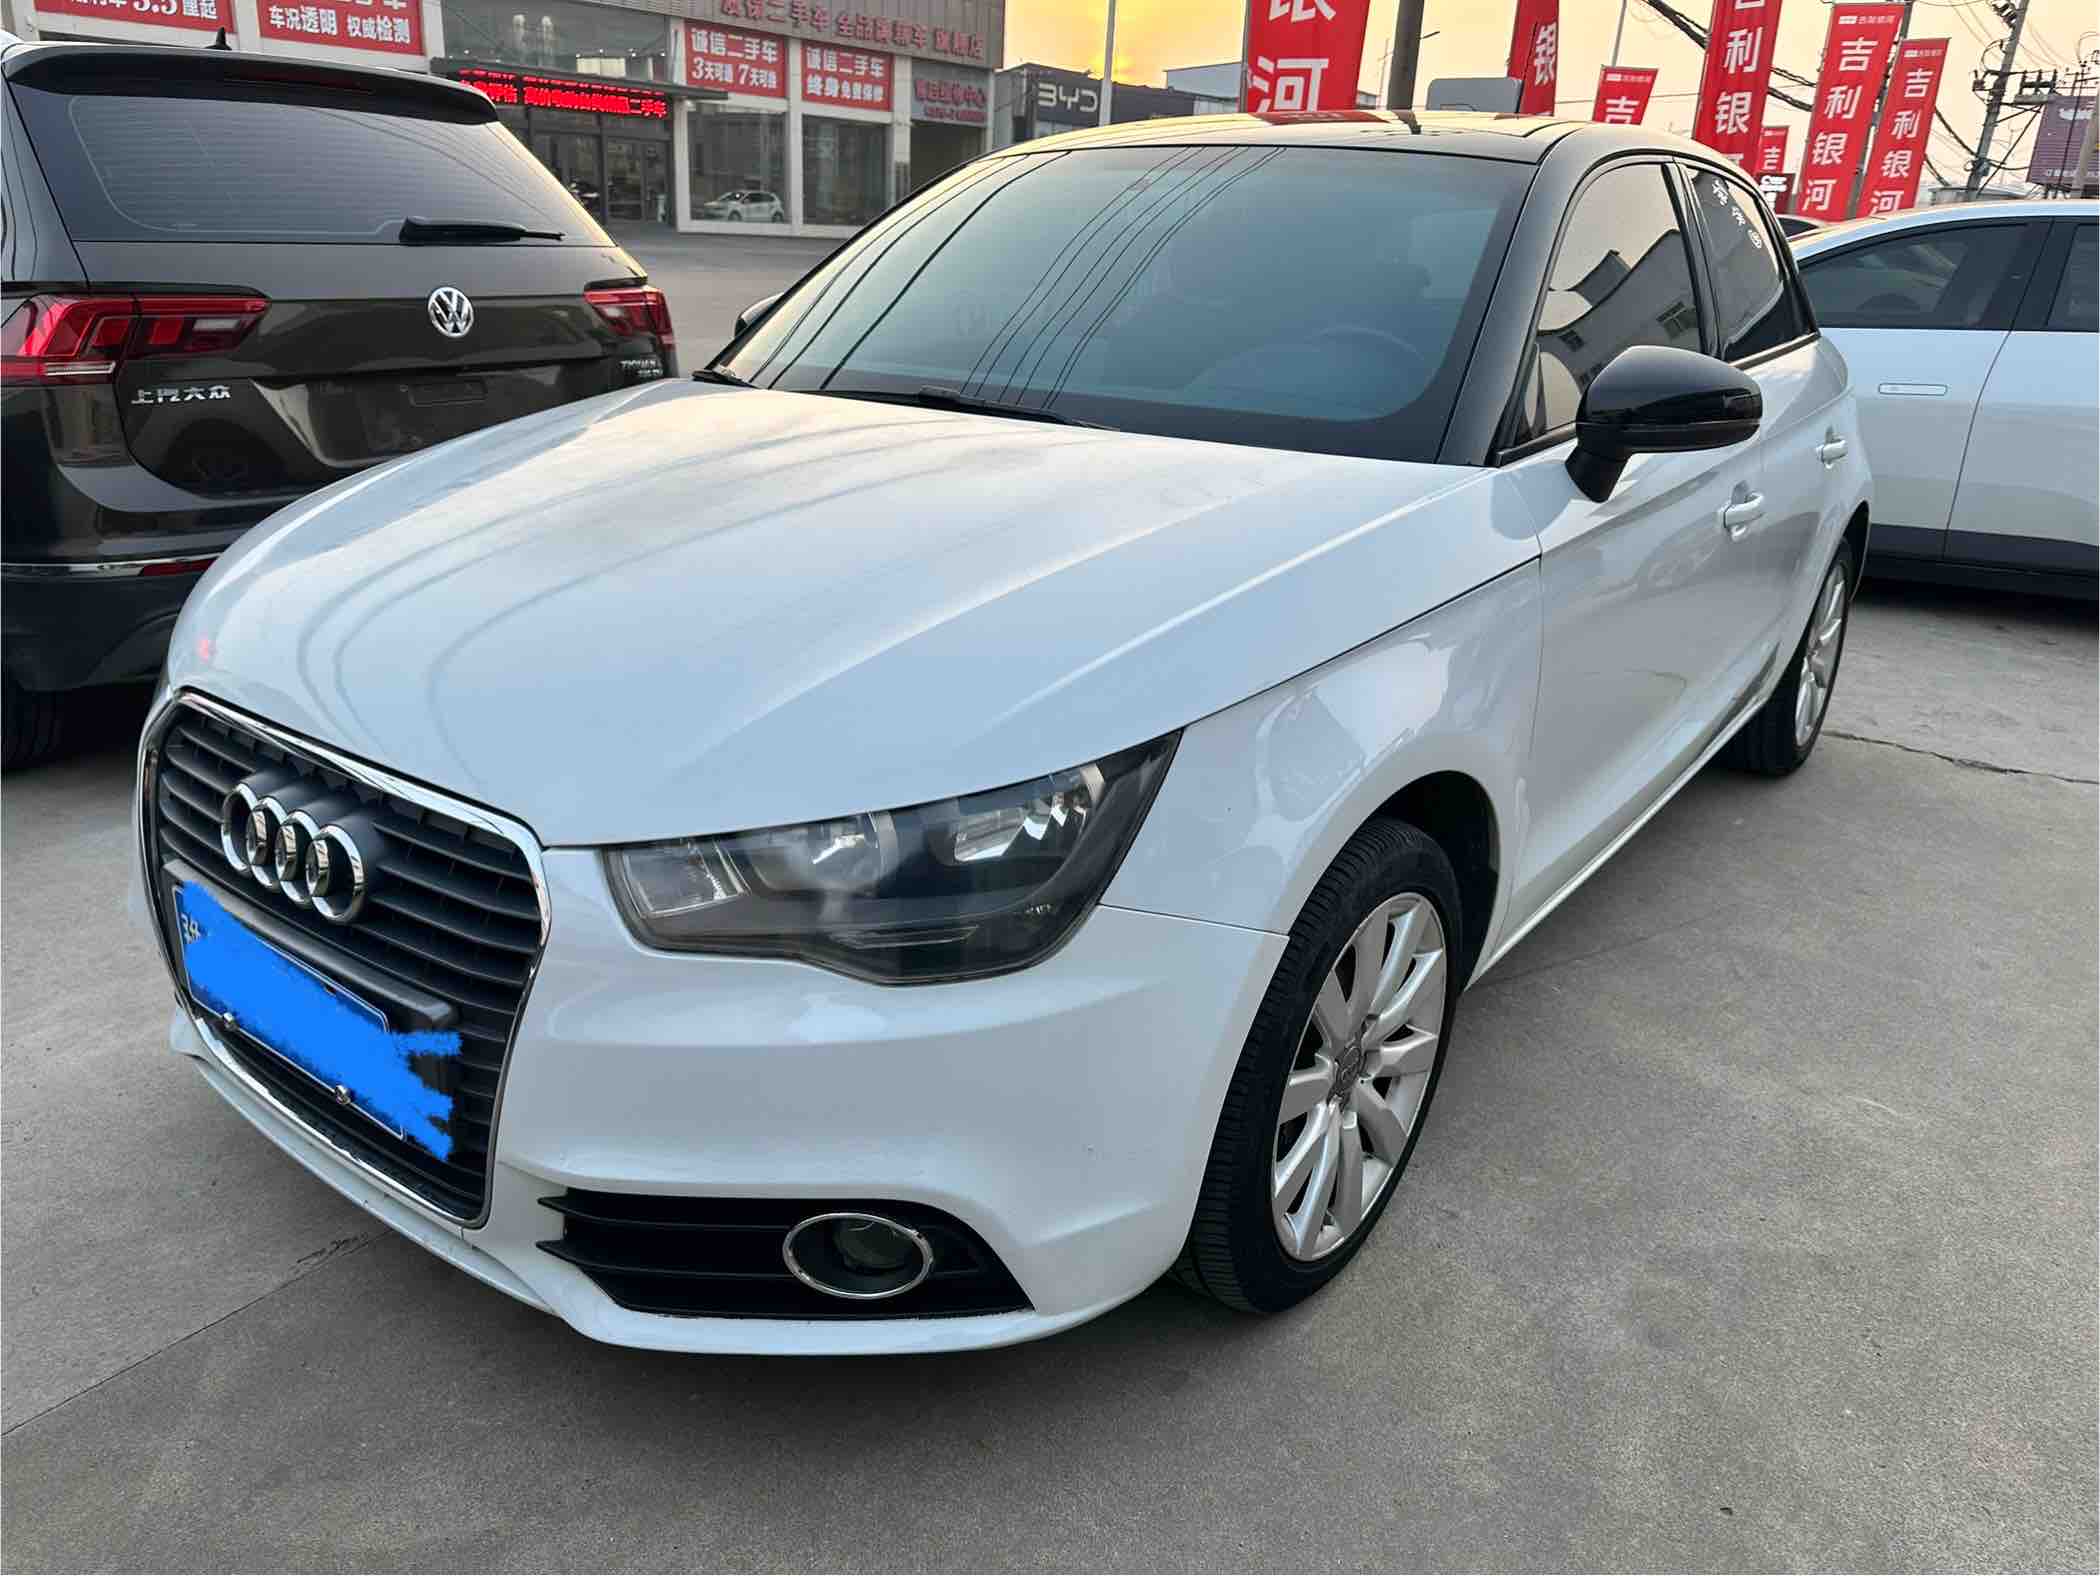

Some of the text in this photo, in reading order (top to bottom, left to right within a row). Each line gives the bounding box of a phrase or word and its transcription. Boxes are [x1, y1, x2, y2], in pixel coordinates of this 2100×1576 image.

[269, 6, 411, 44] 车况透明 权威检测
[691, 28, 778, 64] 诚信二手车
[1038, 82, 1098, 113] BYD
[1715, 0, 1765, 166] 利银
[1604, 96, 1640, 124] 吉
[1802, 36, 1879, 211] 吉利银河
[1869, 68, 1934, 217] 吉利银河
[131, 385, 231, 404] 上汽大众
